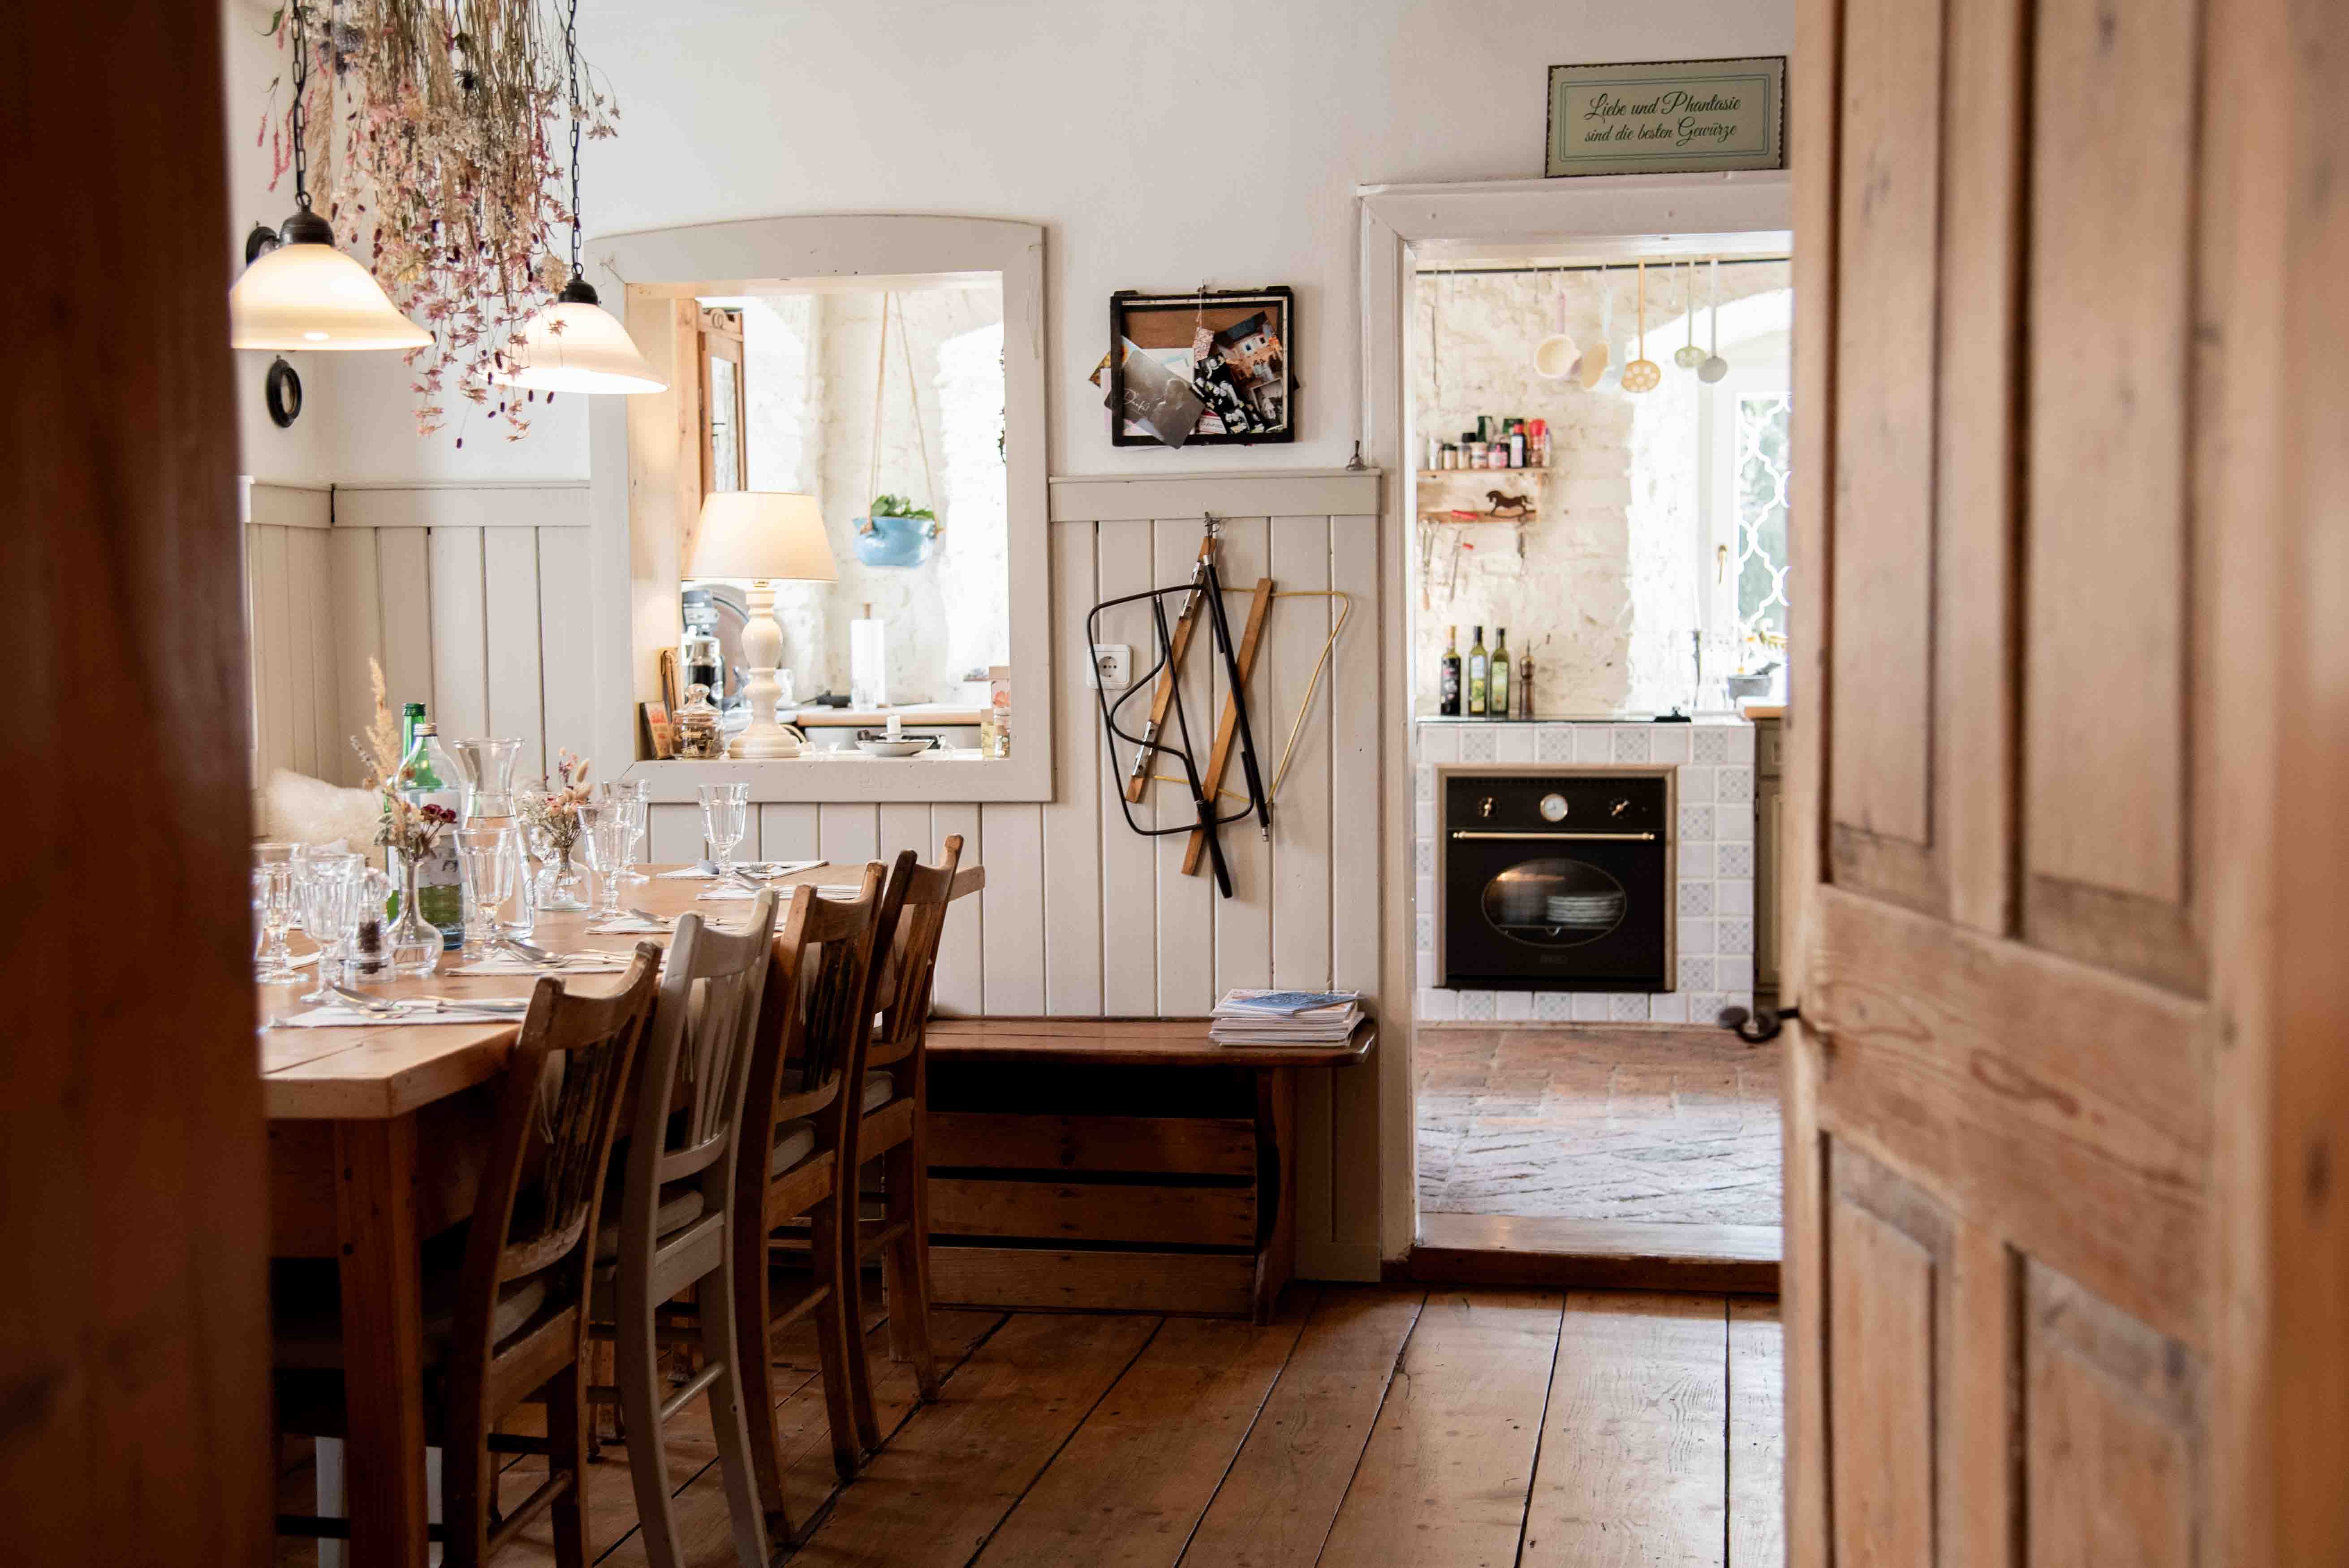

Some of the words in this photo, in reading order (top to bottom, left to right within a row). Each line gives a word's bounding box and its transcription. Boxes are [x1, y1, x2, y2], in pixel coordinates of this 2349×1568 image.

[1584, 93, 1627, 124] Liebe
[1631, 96, 1660, 115] und
[1661, 90, 1741, 114] Phantasie
[1584, 125, 1614, 142] sind
[1615, 124, 1635, 140] die
[1638, 123, 1673, 140] besten
[1676, 116, 1737, 146] Gewürze
